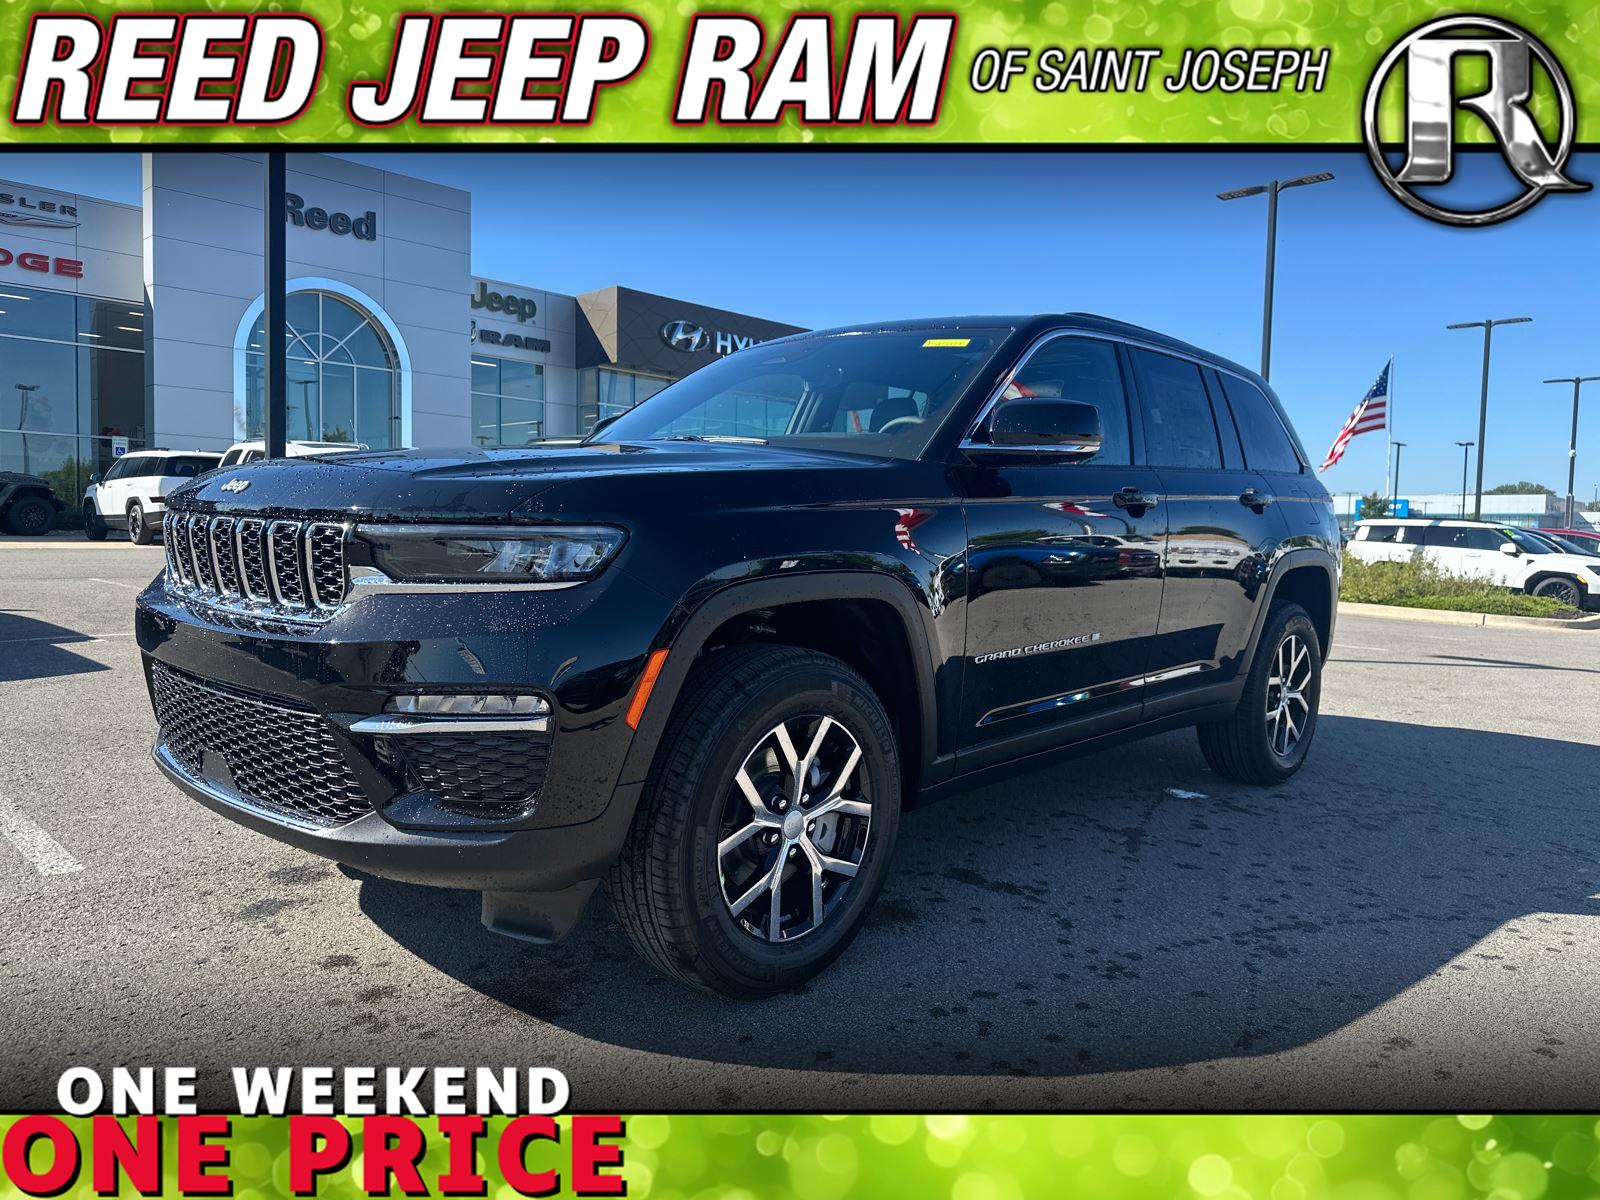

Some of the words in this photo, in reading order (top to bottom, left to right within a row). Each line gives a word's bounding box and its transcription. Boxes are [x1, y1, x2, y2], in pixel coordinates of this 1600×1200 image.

[285, 191, 377, 241] Reed
[471, 282, 537, 322] Jeep
[480, 314, 551, 353] RAM
[221, 477, 250, 494] Jeep
[974, 648, 1021, 665] GRAND
[1024, 634, 1090, 654] CHEROKEE
